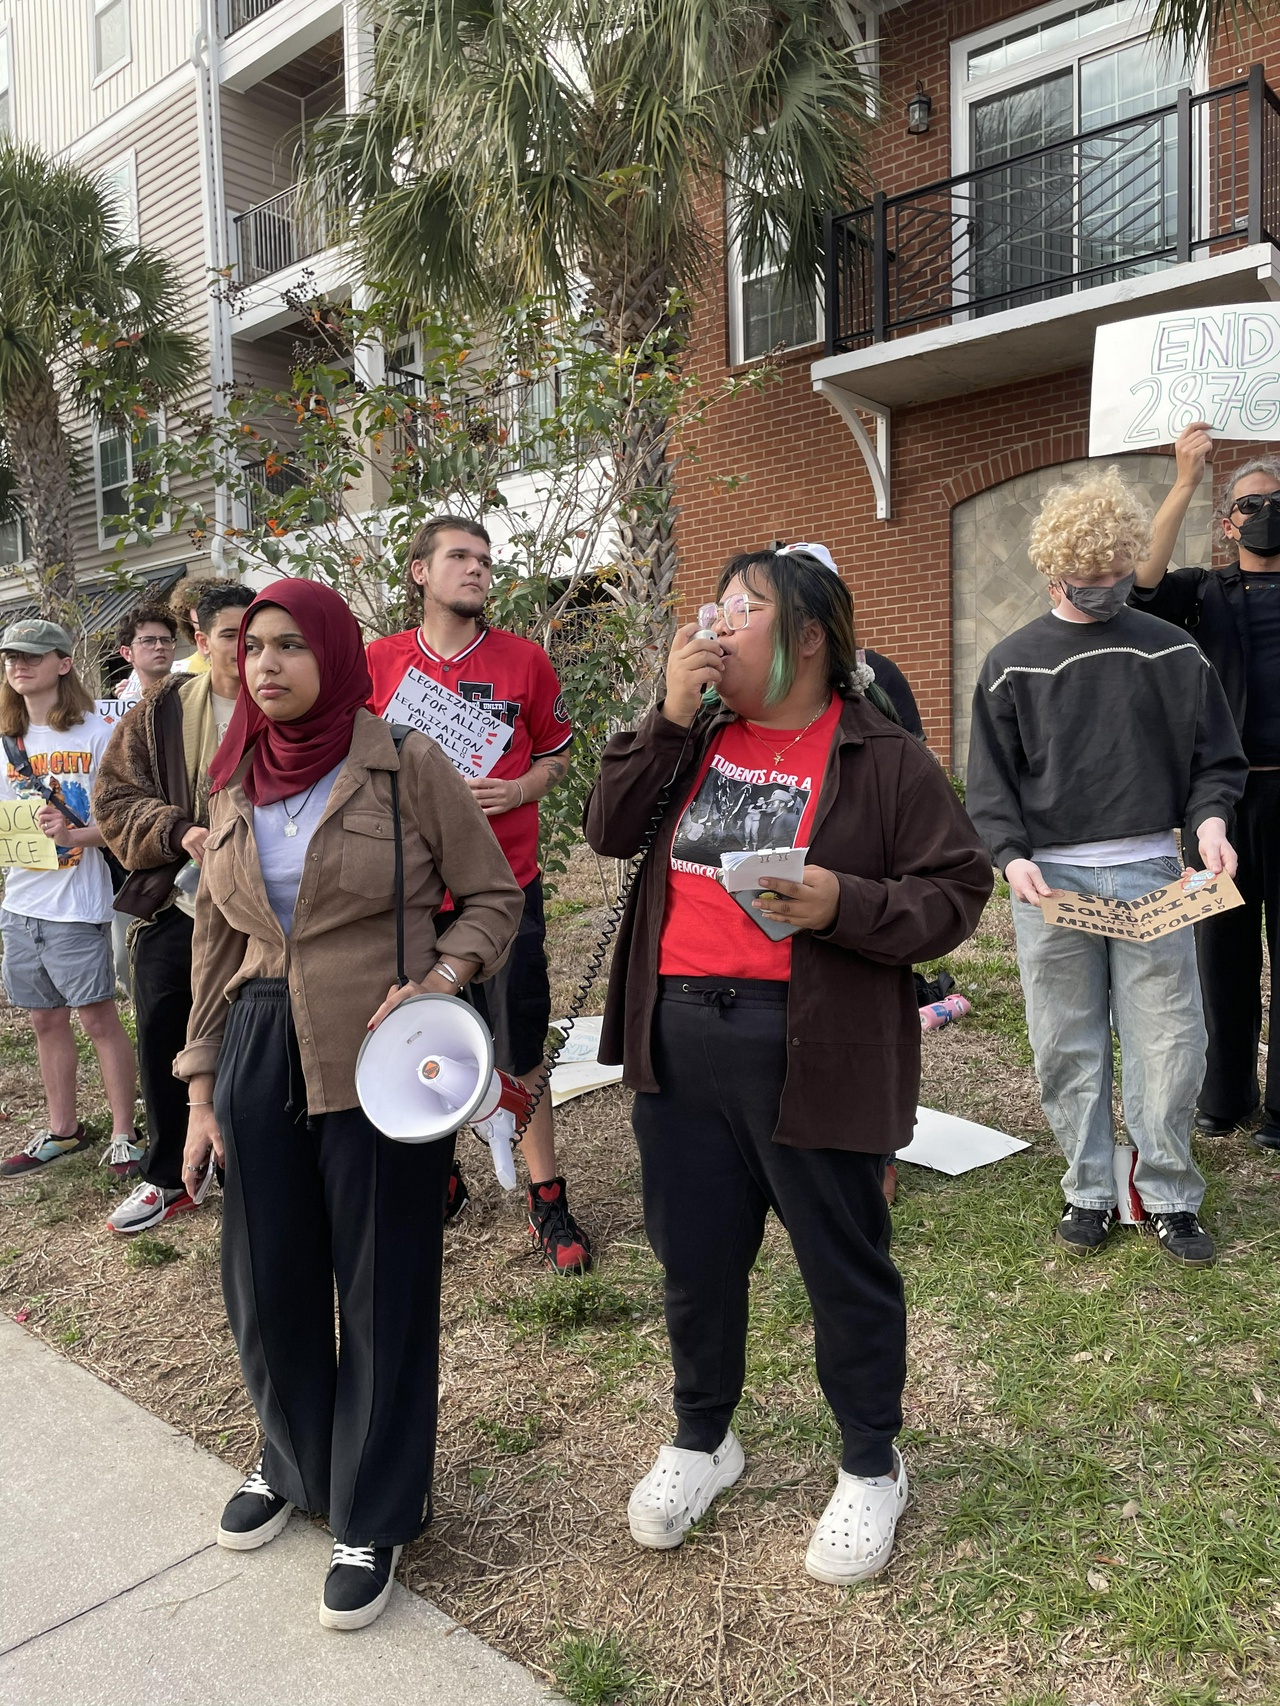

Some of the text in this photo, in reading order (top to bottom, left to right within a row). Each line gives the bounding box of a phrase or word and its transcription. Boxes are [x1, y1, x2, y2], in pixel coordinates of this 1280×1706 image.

[1151, 312, 1280, 375] END
[1123, 372, 1280, 443] 287G
[407, 668, 500, 730] LEGALIZATION
[421, 692, 448, 716] FOR
[394, 691, 484, 753] LEGALIZATION
[407, 713, 432, 735] FOR
[50, 751, 92, 775] CITY
[709, 753, 812, 790] TUDENTS FOR A
[0, 803, 41, 833] UCK
[1, 837, 41, 864] ICE
[1058, 883, 1218, 924] SOLIDARITY
[1078, 888, 1168, 912] STAND
